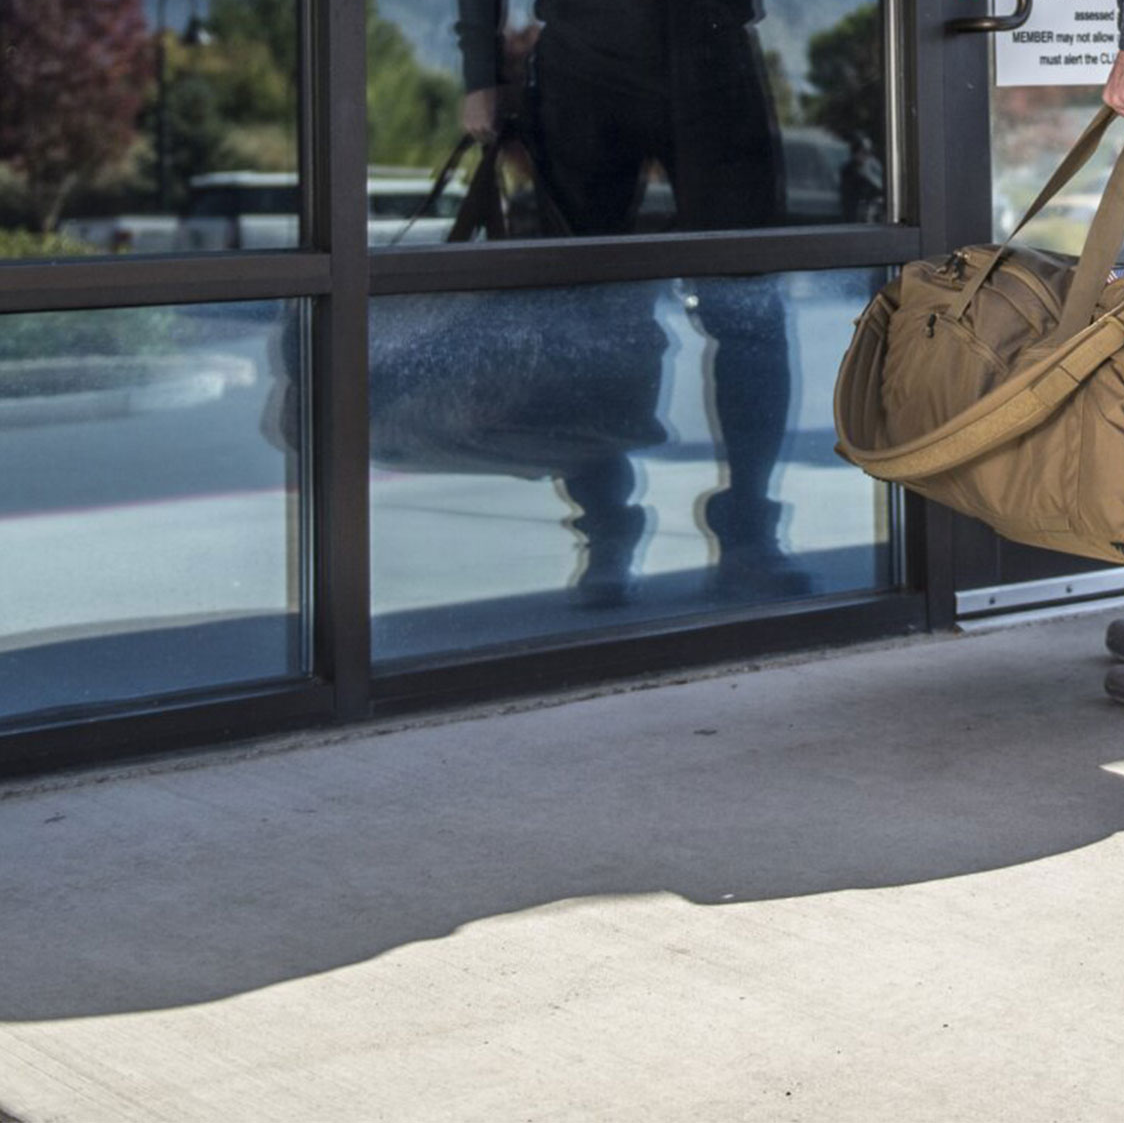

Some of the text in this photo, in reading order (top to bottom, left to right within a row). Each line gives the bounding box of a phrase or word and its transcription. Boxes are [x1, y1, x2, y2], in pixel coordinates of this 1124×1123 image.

[1074, 10, 1115, 21] assessed
[1012, 31, 1115, 46] MEMBER may not allow
[1039, 54, 1062, 65] must
[1063, 54, 1083, 65] alert
[1084, 54, 1098, 65] the
